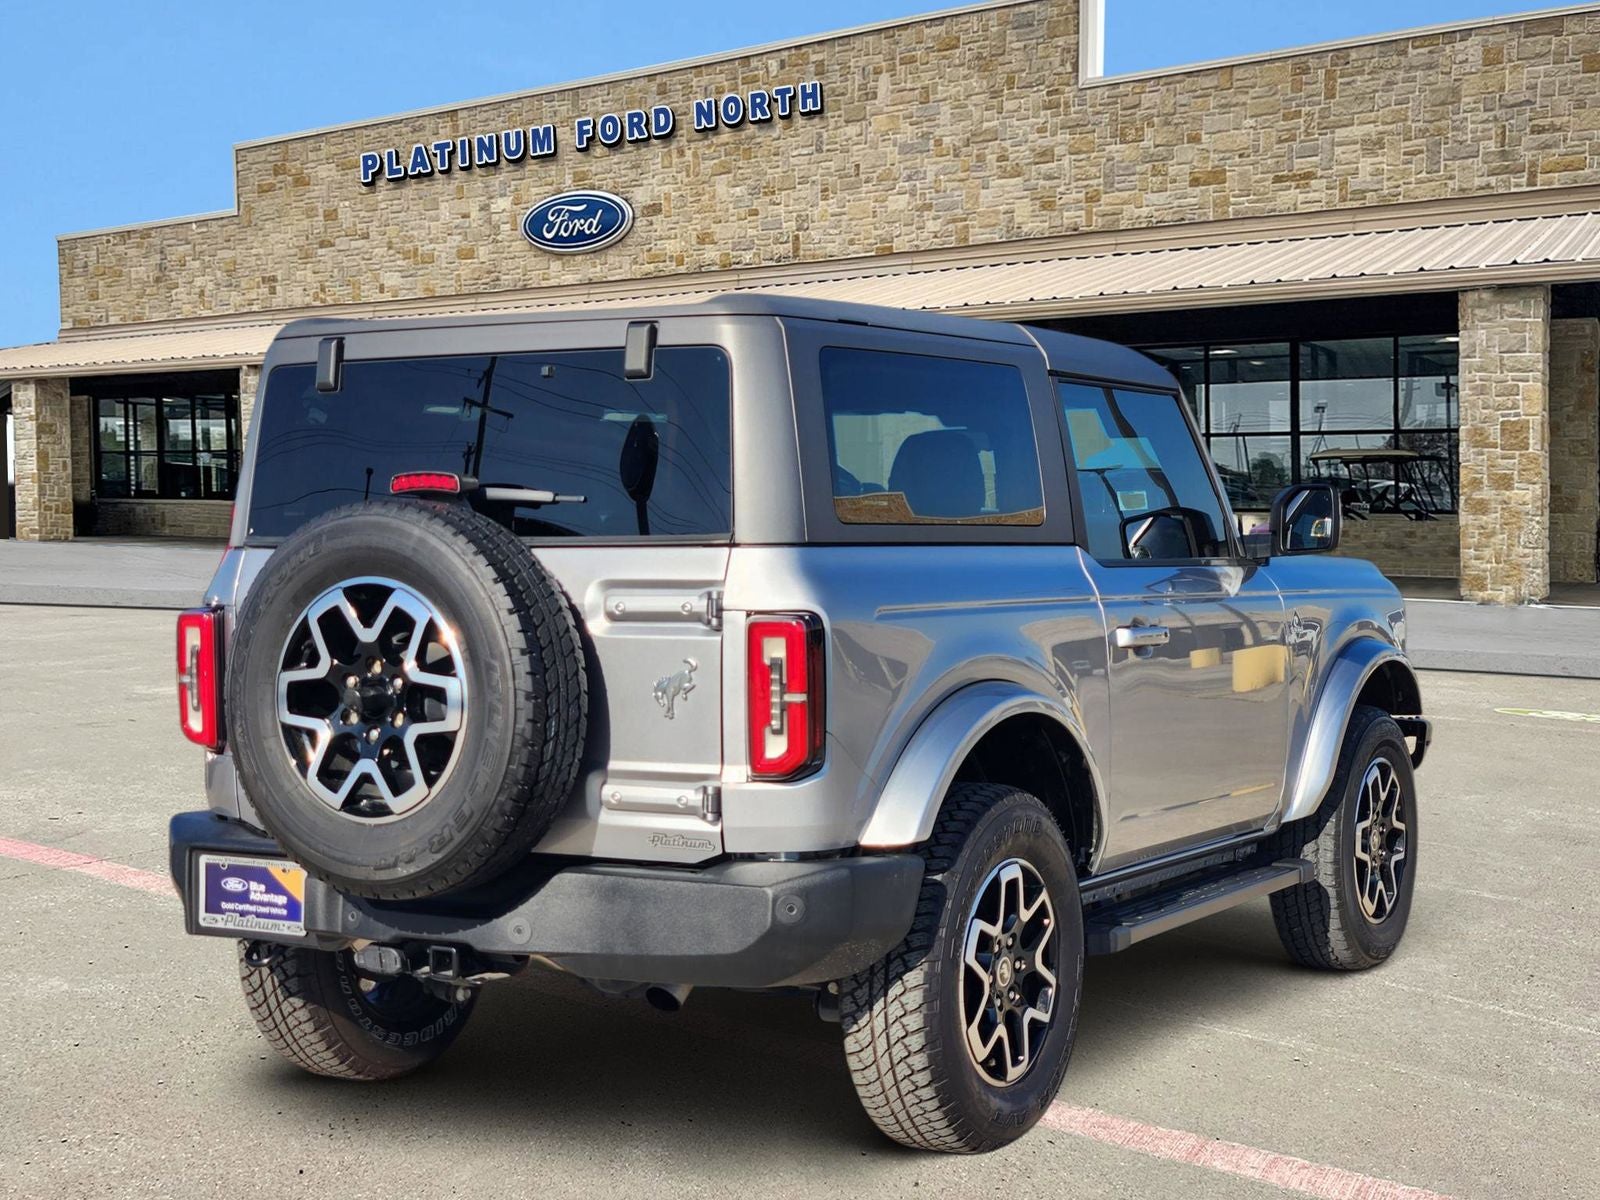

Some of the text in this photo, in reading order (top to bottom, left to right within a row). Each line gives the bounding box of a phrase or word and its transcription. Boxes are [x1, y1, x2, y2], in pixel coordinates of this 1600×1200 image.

[360, 81, 824, 186] PLATINUM FORD NORTH
[541, 203, 603, 240] Ford
[650, 833, 714, 850] Platinum
[249, 881, 266, 892] Blue
[250, 892, 287, 905] Advantage
[221, 902, 234, 910] Gold
[235, 903, 256, 912] Certified
[270, 908, 287, 916] Vehicle
[224, 914, 282, 931] Platinum
[335, 949, 460, 1046] RIDGESTONE
